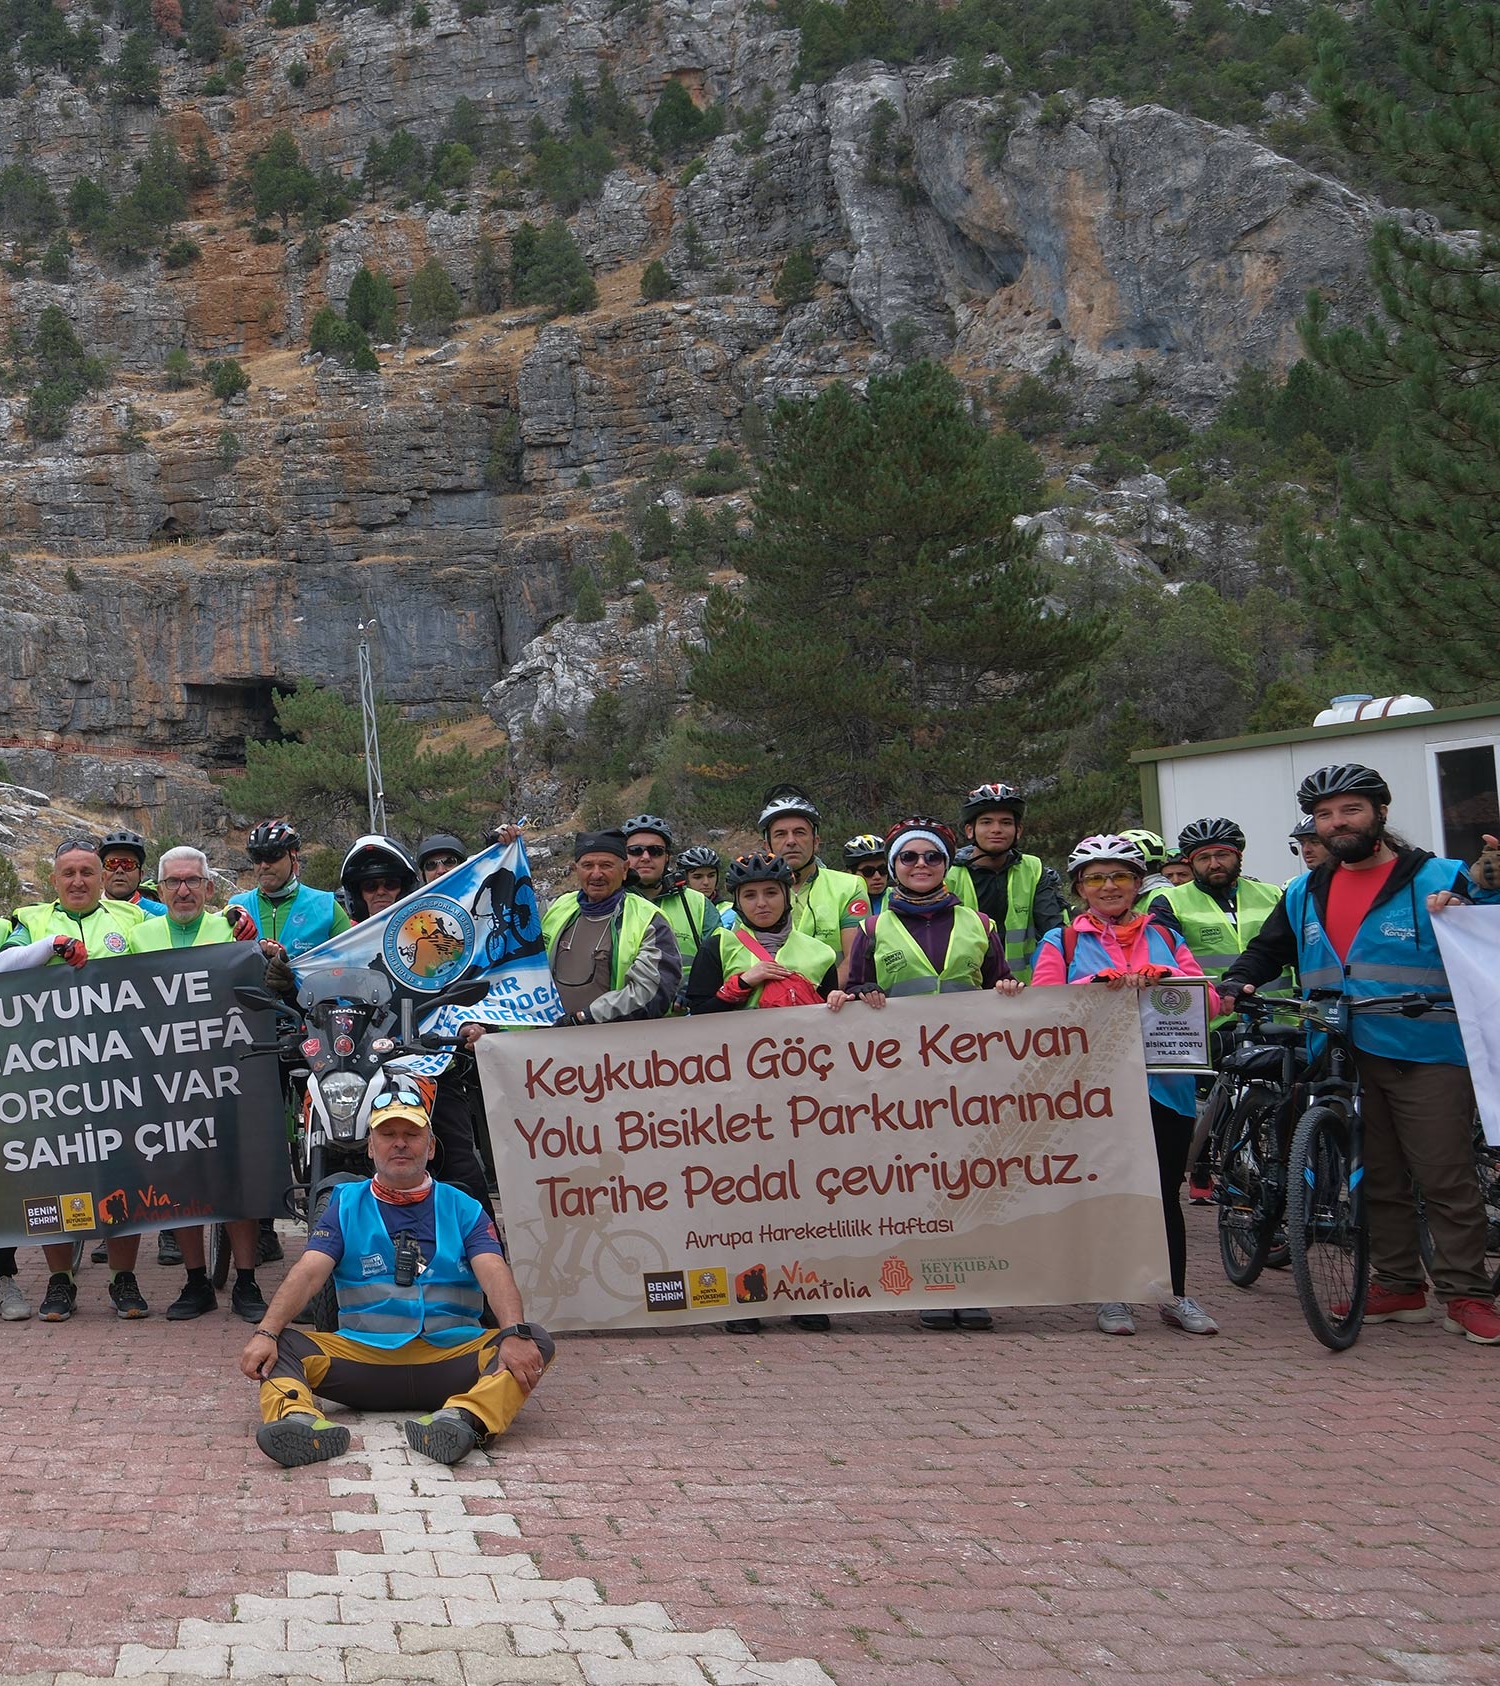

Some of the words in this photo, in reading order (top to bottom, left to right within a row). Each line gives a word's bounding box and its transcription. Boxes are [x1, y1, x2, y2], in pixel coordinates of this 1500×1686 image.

[151, 970, 213, 1006] VE
[140, 1006, 255, 1058] VEFÂ
[524, 1043, 731, 1103] Keykubad
[746, 1036, 835, 1082] Göç
[848, 1038, 902, 1073] ve
[918, 1023, 1089, 1067] Kervan
[153, 1064, 243, 1105] VAR
[513, 1115, 602, 1160] Yolu
[614, 1103, 775, 1154] Bisiklet
[786, 1079, 1114, 1138] Parkurlarında
[2, 1123, 124, 1173] SAHİP
[134, 1116, 218, 1162] ÇIK!
[137, 1184, 171, 1208] Via
[535, 1174, 669, 1218] Tarihe
[681, 1158, 801, 1209] Pedal
[815, 1151, 1098, 1205] çeviriyoruz.
[27, 1205, 57, 1218] BENİM
[29, 1215, 59, 1227] ŞEHRİM
[685, 1230, 753, 1250] Avrupa
[758, 1218, 873, 1244] Hareketlililk
[878, 1216, 955, 1236] Haftası
[781, 1260, 819, 1285] Via
[921, 1259, 1010, 1273] KEYKUBAD
[647, 1280, 683, 1292] BENİM
[773, 1278, 872, 1301] Anatolia
[922, 1273, 966, 1285] YOLU
[648, 1291, 684, 1303] ŞEHRİM
